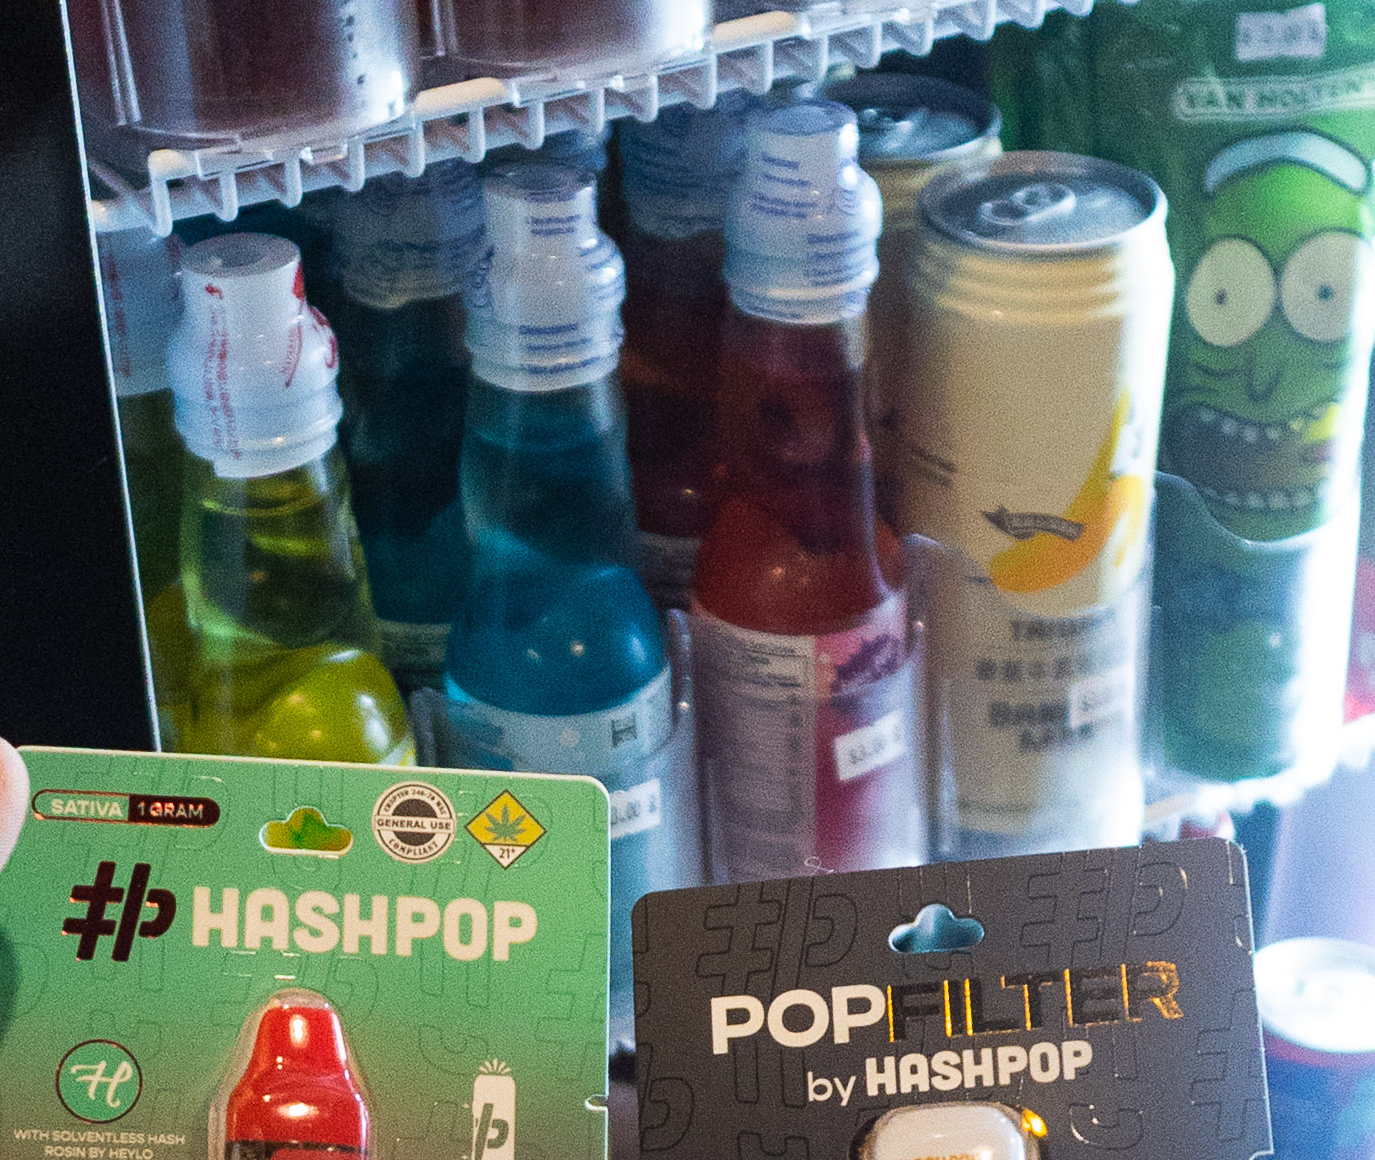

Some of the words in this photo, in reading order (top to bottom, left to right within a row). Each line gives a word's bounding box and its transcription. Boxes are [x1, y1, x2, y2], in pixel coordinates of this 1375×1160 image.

[51, 798, 123, 818] SATIVA
[137, 801, 145, 816] 1
[150, 802, 205, 820] GRAM
[377, 818, 426, 830] GENERAL
[430, 820, 452, 831] USE
[389, 838, 439, 856] COMPLIANT
[192, 886, 539, 962] HASHPOP
[807, 1070, 857, 1107] by
[865, 1039, 1093, 1097] HASHPOP
[14, 1128, 50, 1141] WITH
[52, 1130, 145, 1145] SOLVENTLESS
[148, 1133, 186, 1146] HASH
[44, 1145, 87, 1159] ROSIN
[89, 1146, 106, 1159] BY
[109, 1147, 154, 1160] HEYLO
